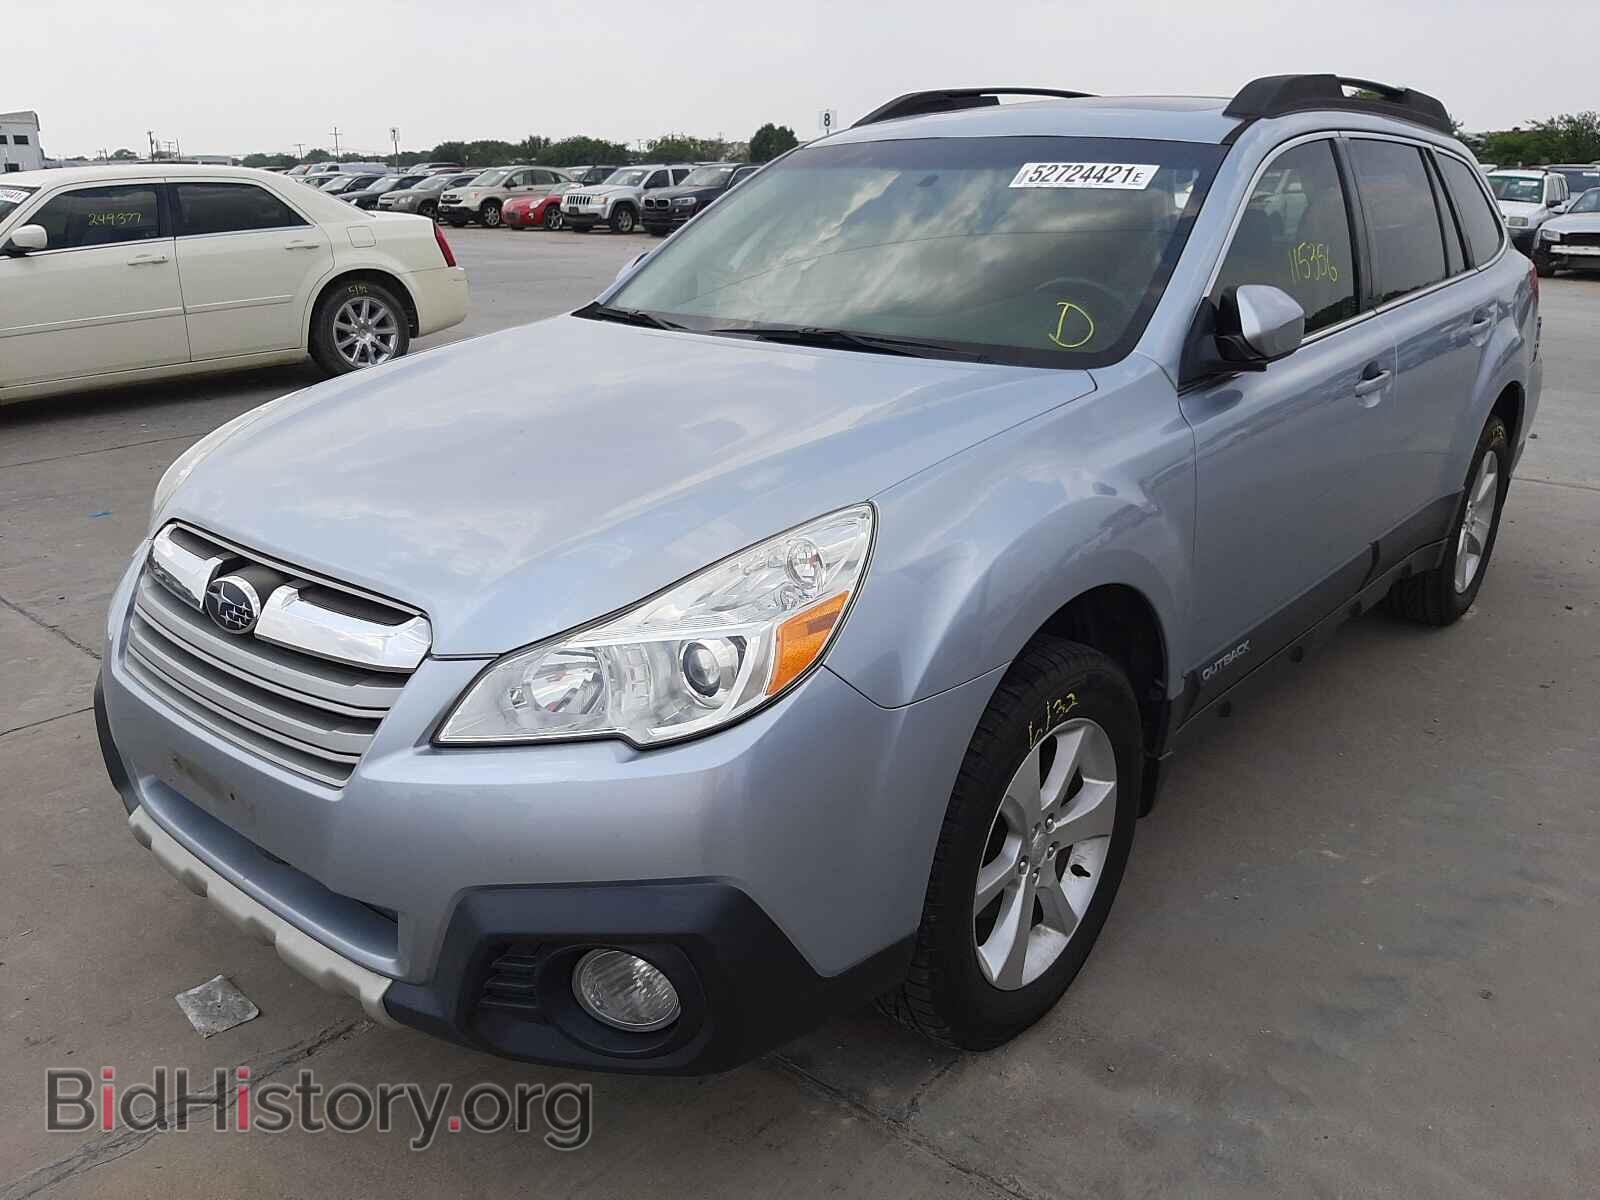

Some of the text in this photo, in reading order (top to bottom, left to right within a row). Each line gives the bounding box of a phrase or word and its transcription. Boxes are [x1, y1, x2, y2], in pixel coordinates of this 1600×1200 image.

[823, 112, 831, 127] 8
[1028, 164, 1136, 184] 52724421
[1048, 302, 1094, 347] D
[1202, 639, 1250, 680] OUTBACK
